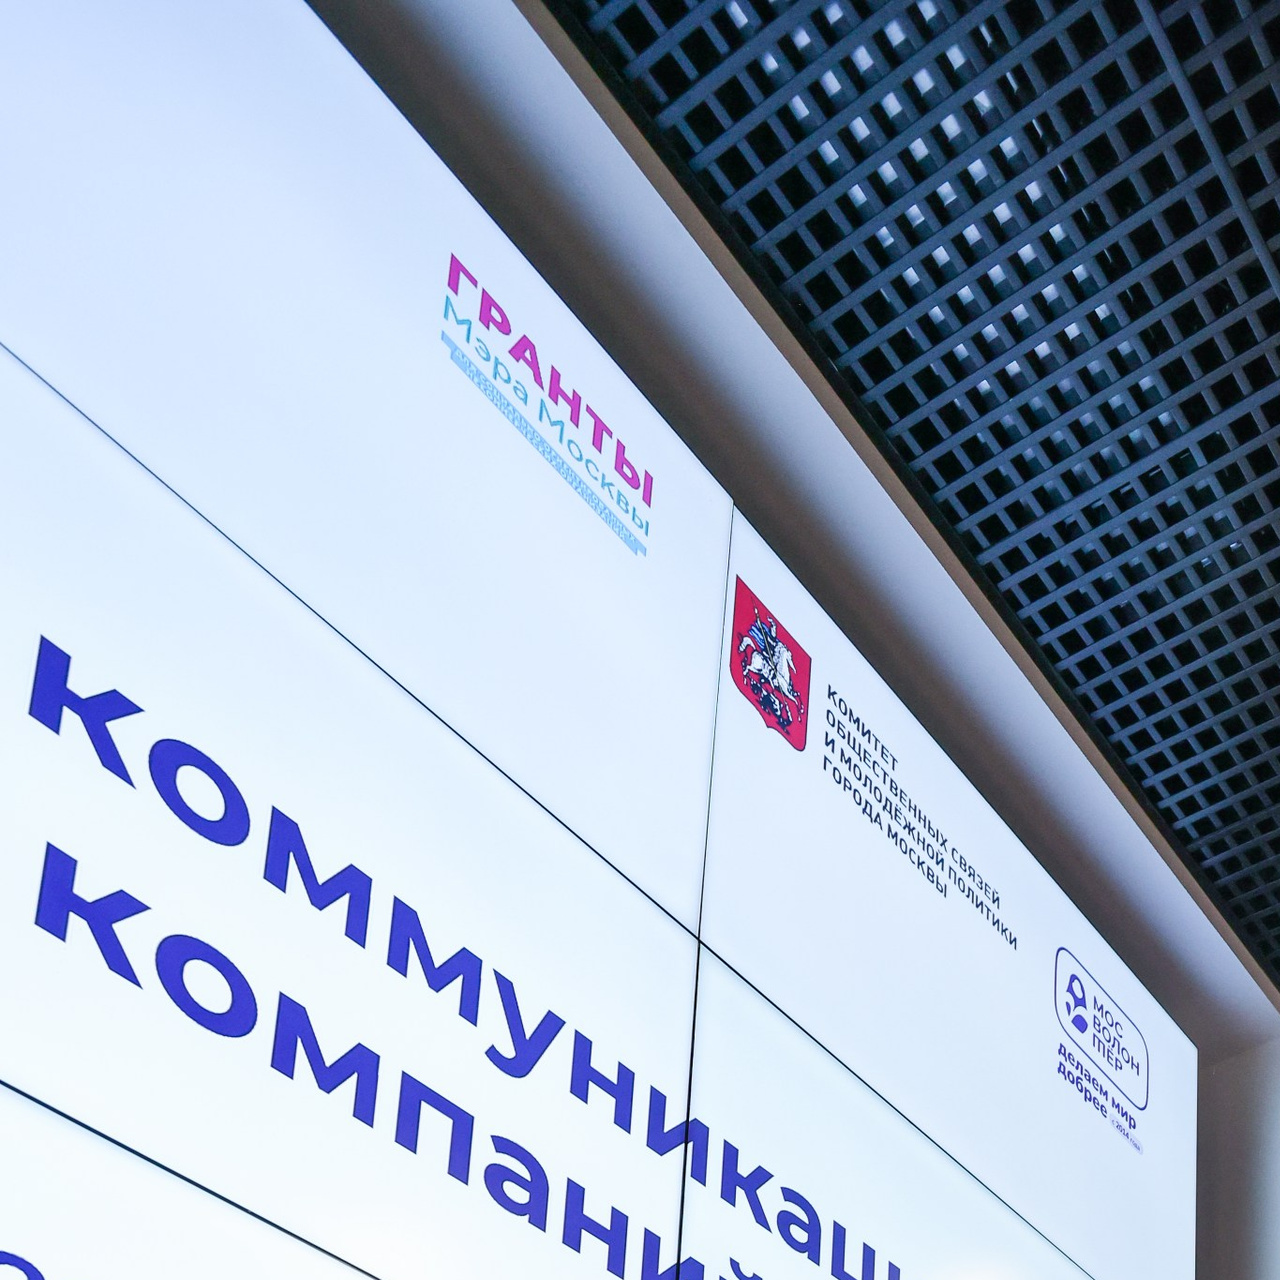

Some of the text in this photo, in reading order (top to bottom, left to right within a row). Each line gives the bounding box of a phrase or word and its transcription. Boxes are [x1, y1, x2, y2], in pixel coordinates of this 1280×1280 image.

[443, 294, 649, 536] Мэра Москвы
[447, 252, 653, 508] ГРАНТЫ
[828, 684, 898, 771] КОМИТЕТ
[823, 755, 947, 898] ГОРОДА МОСКВЫ
[825, 709, 1000, 910] ОБЩЕСТВЕННЫХ СВЯЗЕЙ
[825, 731, 1017, 950] И МОЛОДЁЖНОЙ ПОЛИТИКИ
[1093, 1014, 1139, 1076] ВОЛОН
[1094, 996, 1123, 1038] МОС
[1057, 1061, 1107, 1118] добрее
[1058, 1043, 1136, 1129] делаем мир
